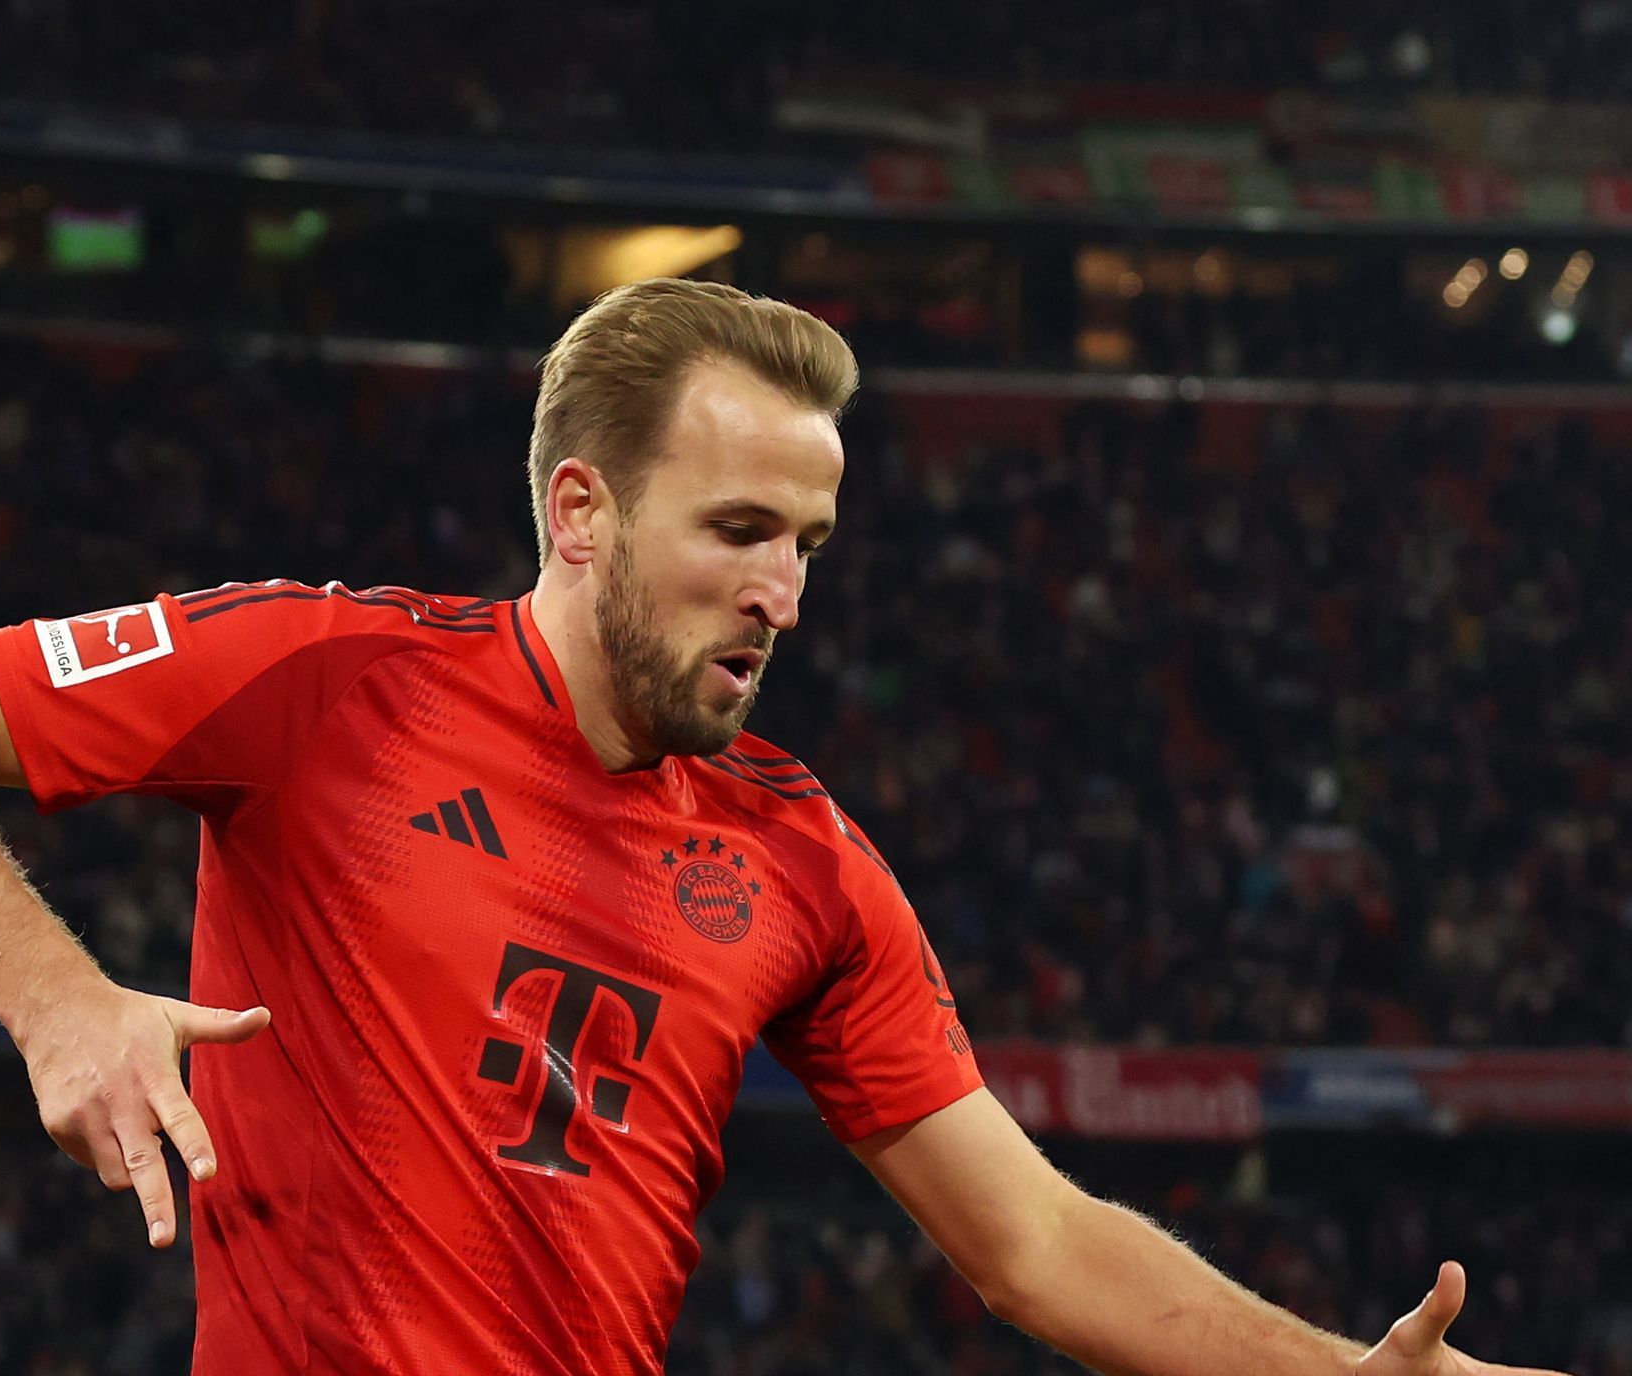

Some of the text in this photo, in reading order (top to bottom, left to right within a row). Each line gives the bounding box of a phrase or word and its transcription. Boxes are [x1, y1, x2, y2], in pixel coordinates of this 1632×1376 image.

[46, 622, 73, 677] DESLIGA
[681, 865, 746, 903] FC BAYERN
[682, 902, 746, 937] MÜNCHEN
